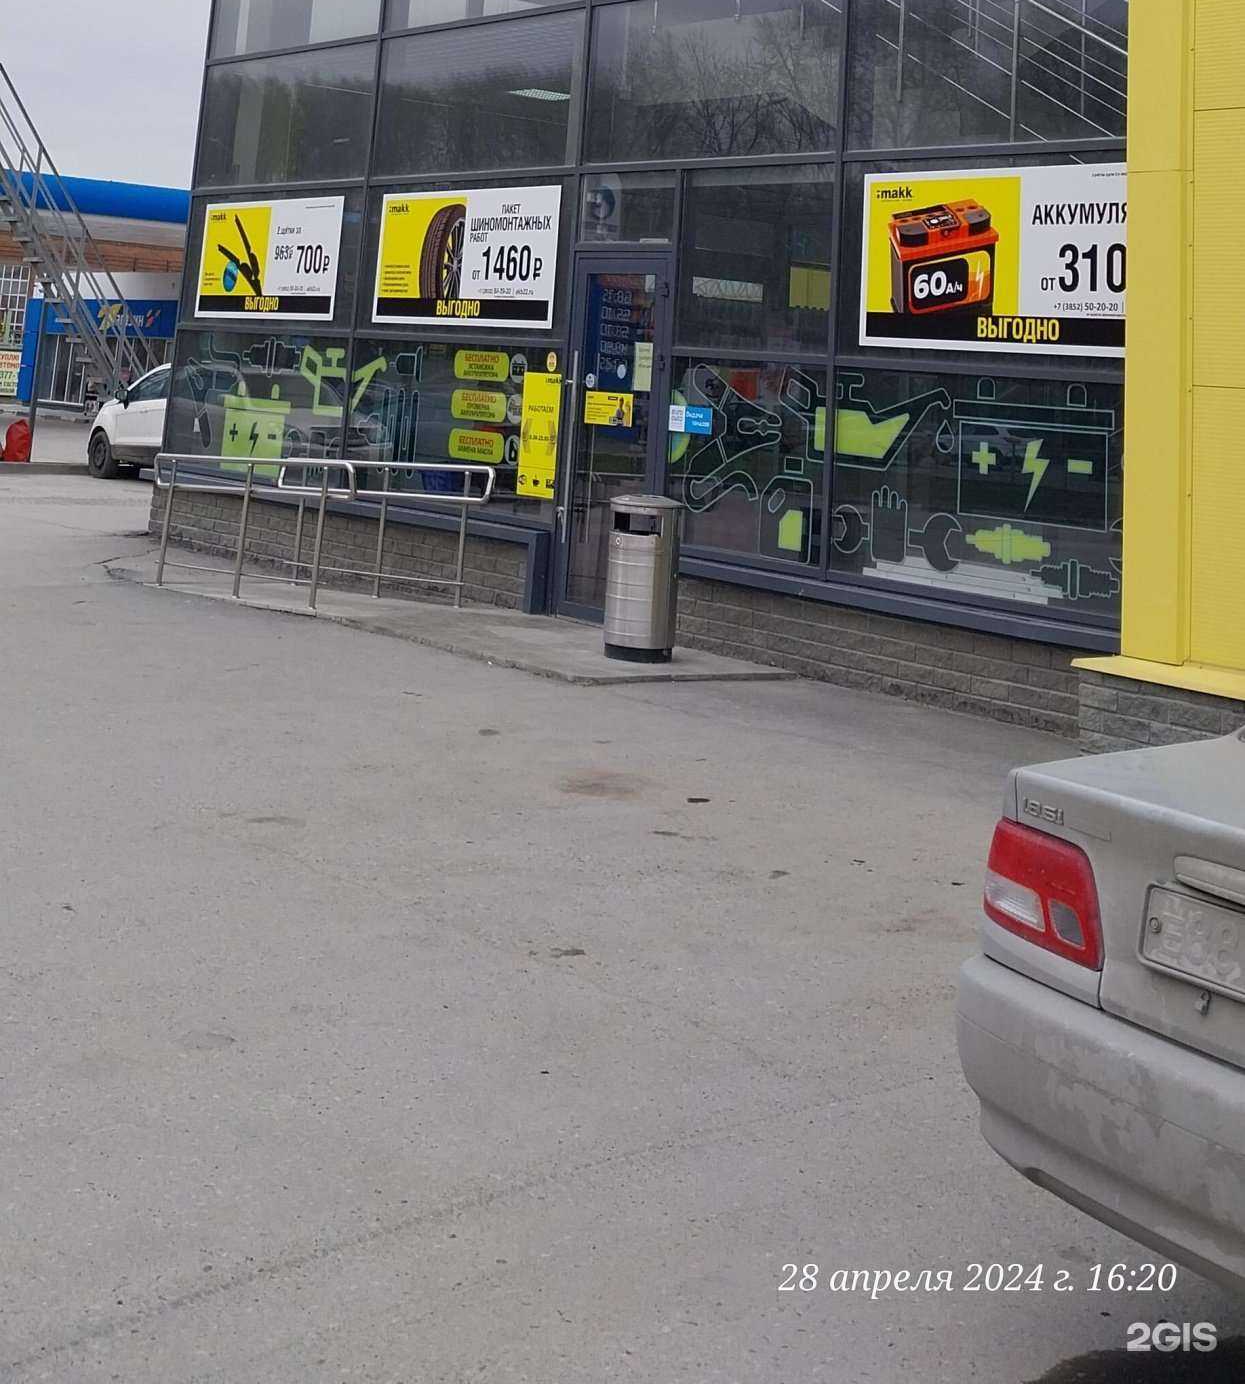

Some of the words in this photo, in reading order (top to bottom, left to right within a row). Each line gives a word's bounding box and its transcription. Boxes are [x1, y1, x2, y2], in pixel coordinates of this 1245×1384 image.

[502, 204, 521, 215] ПАКЕТ
[470, 216, 552, 232] ШИНОМОНТАЖНЫХ
[469, 233, 488, 243] РАБОТ
[244, 297, 279, 312] ВЫГОДНО
[436, 299, 480, 319] ВЫГОДНО
[1084, 302, 1119, 311] 50-20-20
[977, 316, 1060, 343] ВЫГОДНО
